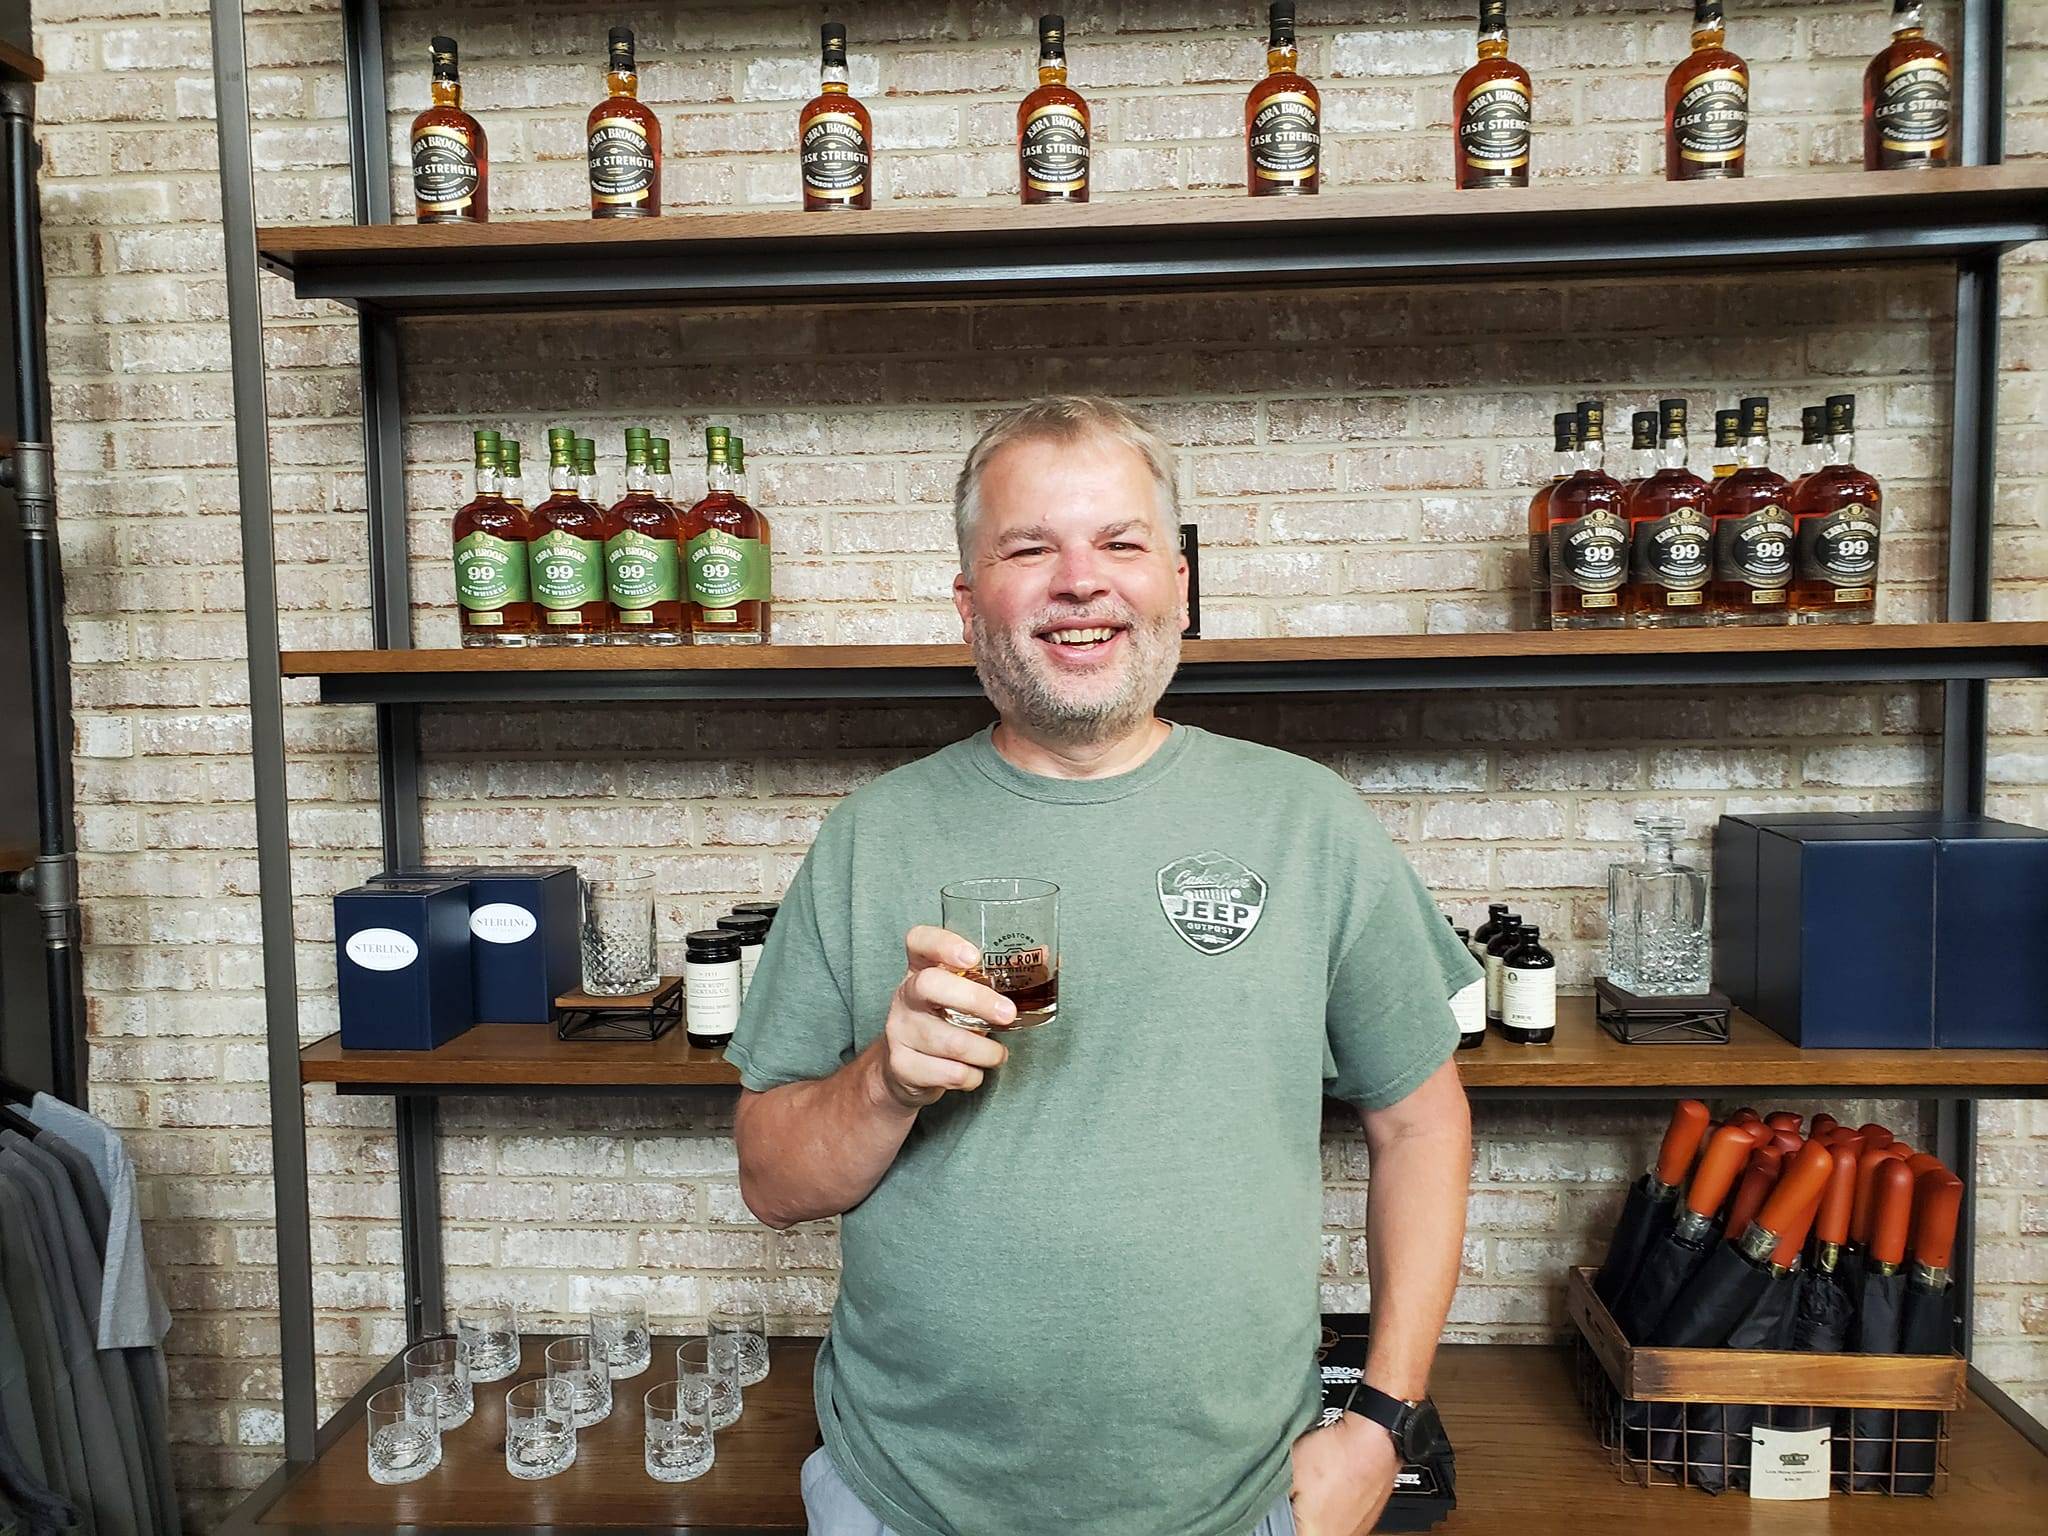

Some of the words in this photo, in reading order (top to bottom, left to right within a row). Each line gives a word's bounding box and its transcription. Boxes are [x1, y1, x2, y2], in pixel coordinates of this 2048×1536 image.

[1256, 105, 1280, 128] EZRA
[1281, 103, 1316, 126] BROOKS
[1875, 102, 1906, 118] CASK
[1027, 117, 1050, 139] EZRA
[1051, 115, 1086, 138] BROOKS
[1460, 121, 1485, 135] CASK
[1674, 113, 1702, 128] CASK
[608, 128, 647, 150] BROOKS
[804, 124, 825, 146] EZRA
[826, 123, 864, 145] BROOKS
[1250, 133, 1272, 147] CASK
[428, 135, 469, 158] BROOKS
[1022, 145, 1043, 158] CASK
[603, 156, 654, 169] STRENGTH
[821, 150, 869, 165] STRENGTH
[425, 163, 477, 176] STRENGTH
[1584, 546, 1615, 562] 99
[1670, 544, 1700, 560] 99
[1756, 542, 1785, 558] 99
[1838, 540, 1869, 556] 99
[467, 566, 496, 581] 99
[545, 565, 574, 580] 99
[618, 565, 646, 579] 99
[702, 563, 730, 578] 99
[1173, 900, 1249, 924] JEEP
[477, 918, 529, 928] STERLING
[1186, 922, 1234, 935] OUTPOST
[993, 932, 1035, 947] BARDSTOWN
[354, 943, 410, 955] STERLING
[988, 955, 1011, 967] LUX
[1017, 951, 1040, 966] ROW
